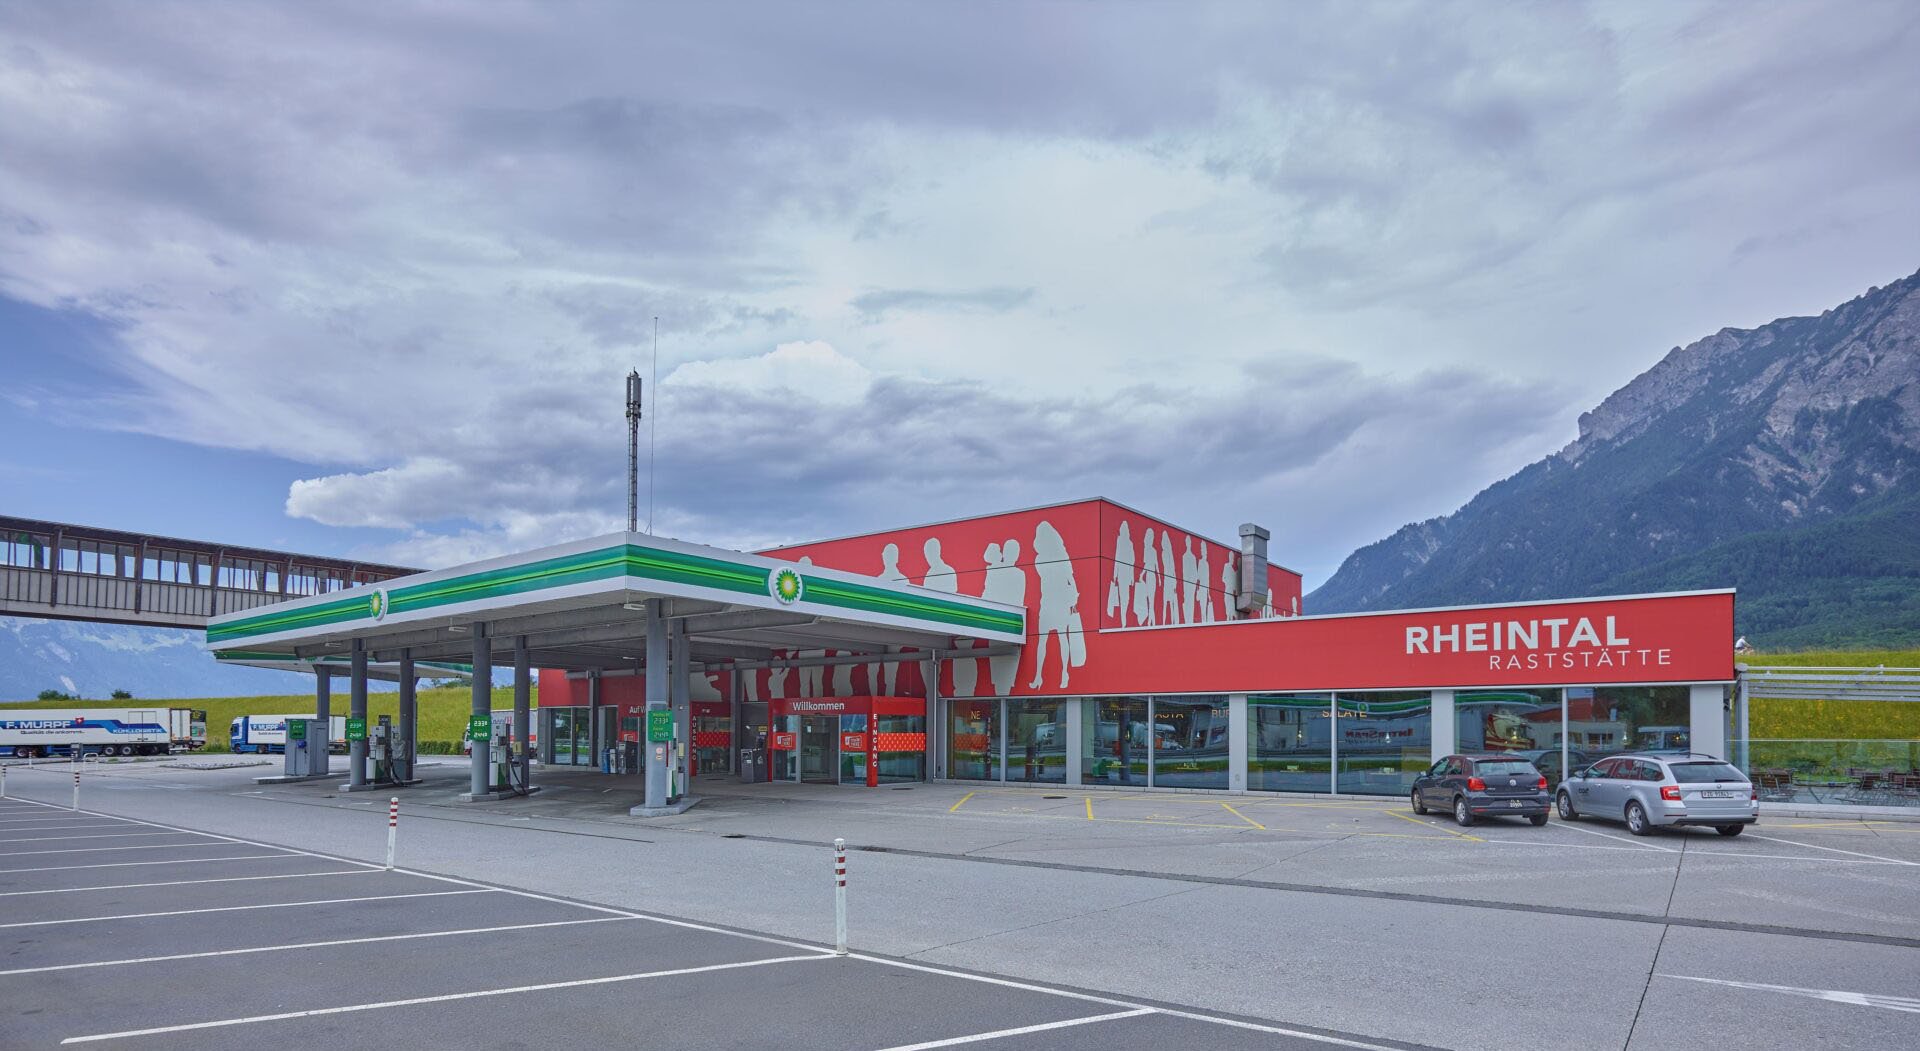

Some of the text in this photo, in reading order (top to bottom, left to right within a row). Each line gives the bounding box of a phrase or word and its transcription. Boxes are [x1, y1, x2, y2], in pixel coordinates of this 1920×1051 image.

[1406, 616, 1630, 654] RHEINTAL
[1489, 648, 1671, 670] RASTSTÄTTE
[793, 702, 845, 711] Willkommen
[1322, 710, 1368, 718] SLATE
[6, 720, 71, 729] F. MURPF
